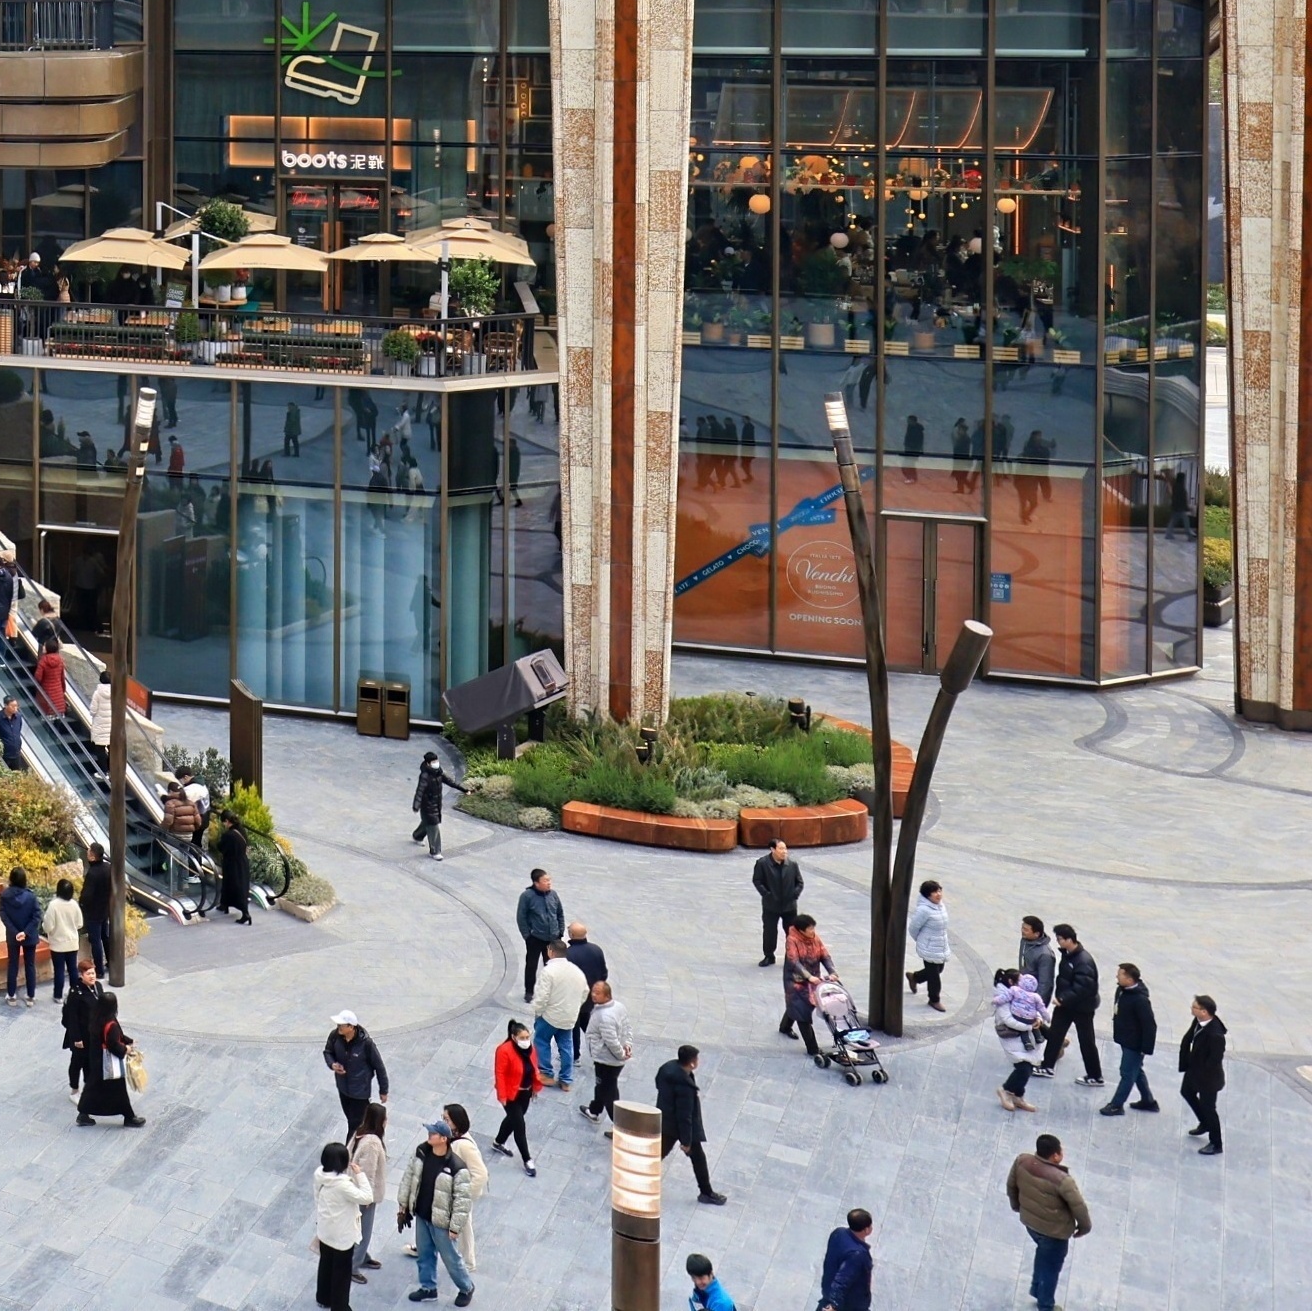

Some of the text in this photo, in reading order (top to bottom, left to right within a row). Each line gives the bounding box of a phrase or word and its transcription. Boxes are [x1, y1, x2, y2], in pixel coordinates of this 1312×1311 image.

[281, 150, 385, 170] boots 泥靴
[166, 293, 185, 301] OPENING
[168, 288, 184, 296] GRAND
[702, 560, 725, 576] GELATO
[736, 539, 761, 555] CHOCO
[795, 559, 856, 583] Venchi
[789, 613, 863, 626] OPENING SOON
